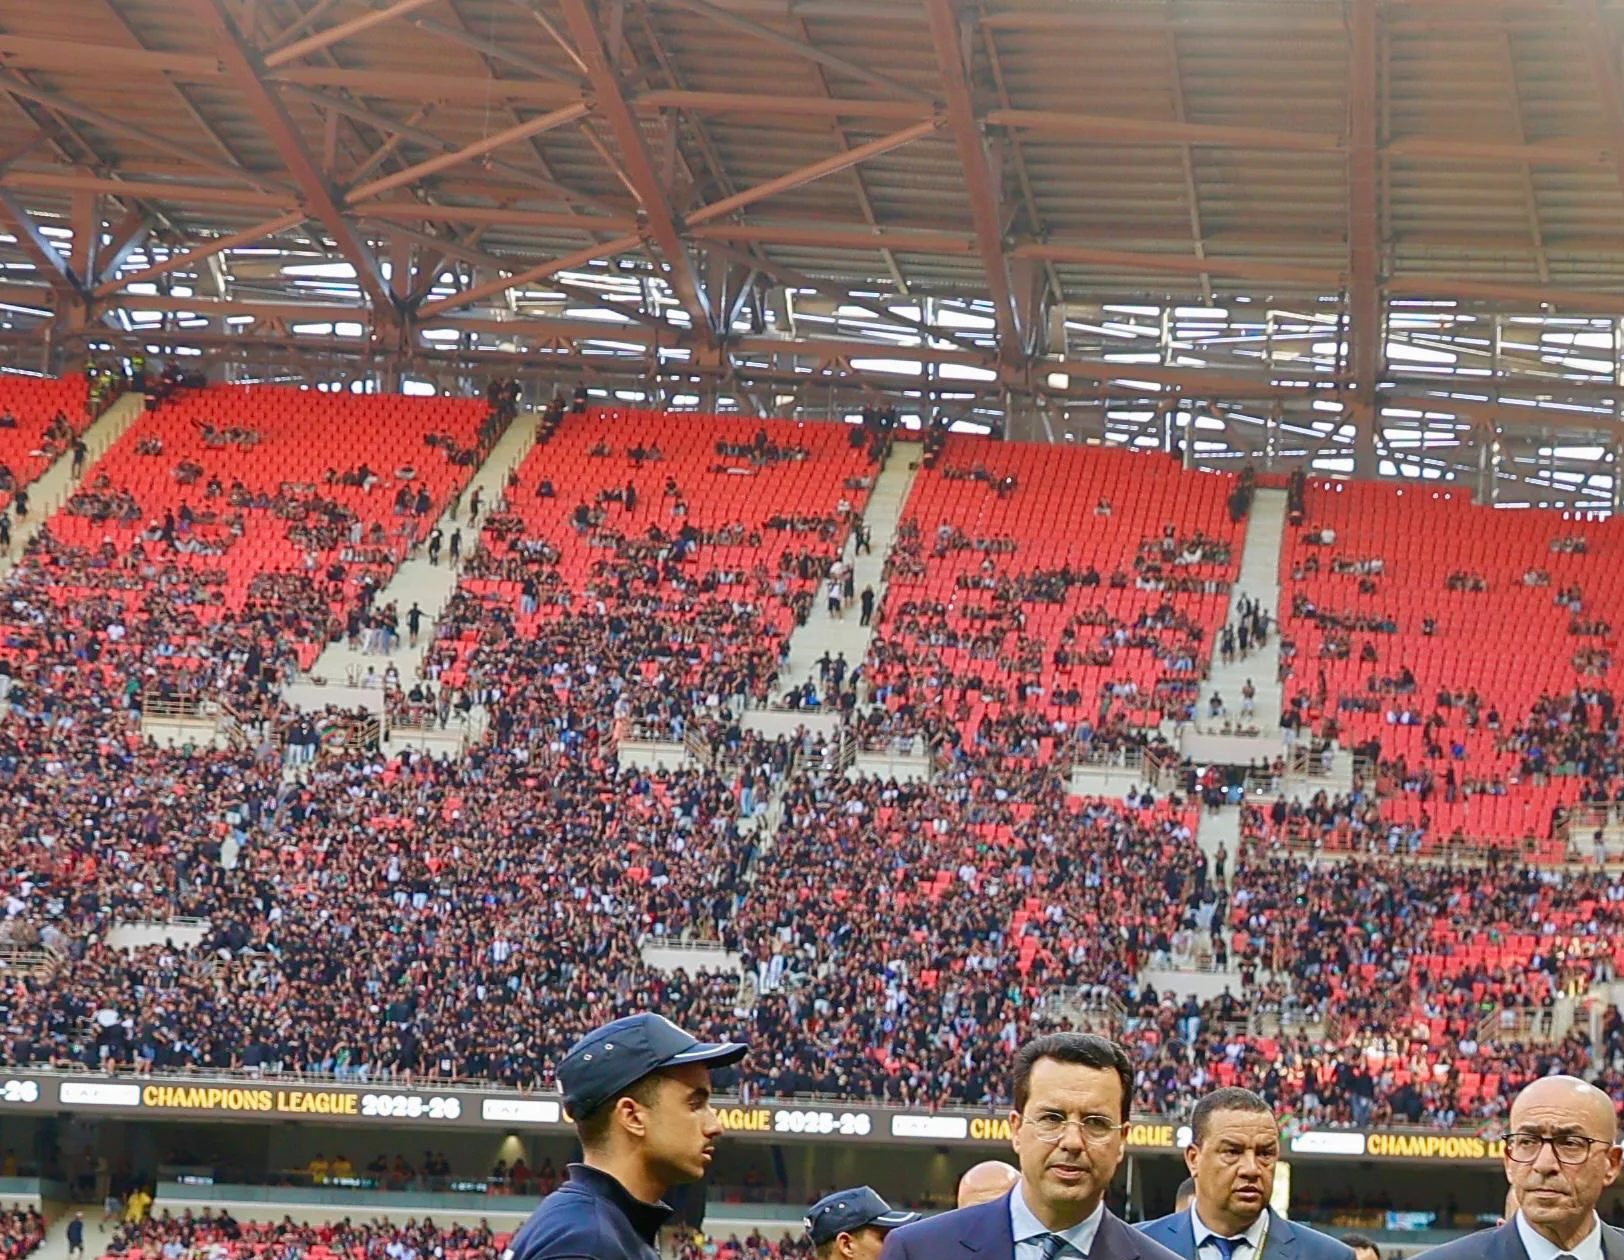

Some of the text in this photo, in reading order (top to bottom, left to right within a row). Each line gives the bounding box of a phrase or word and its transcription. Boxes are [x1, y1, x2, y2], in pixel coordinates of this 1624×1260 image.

[143, 1085, 273, 1111] CHAMPIONS
[277, 1090, 358, 1115] LEAGUE
[361, 1094, 461, 1119] 2025-26
[774, 1110, 871, 1136] 2025-26
[1367, 1134, 1485, 1158] CHAMPIONS
